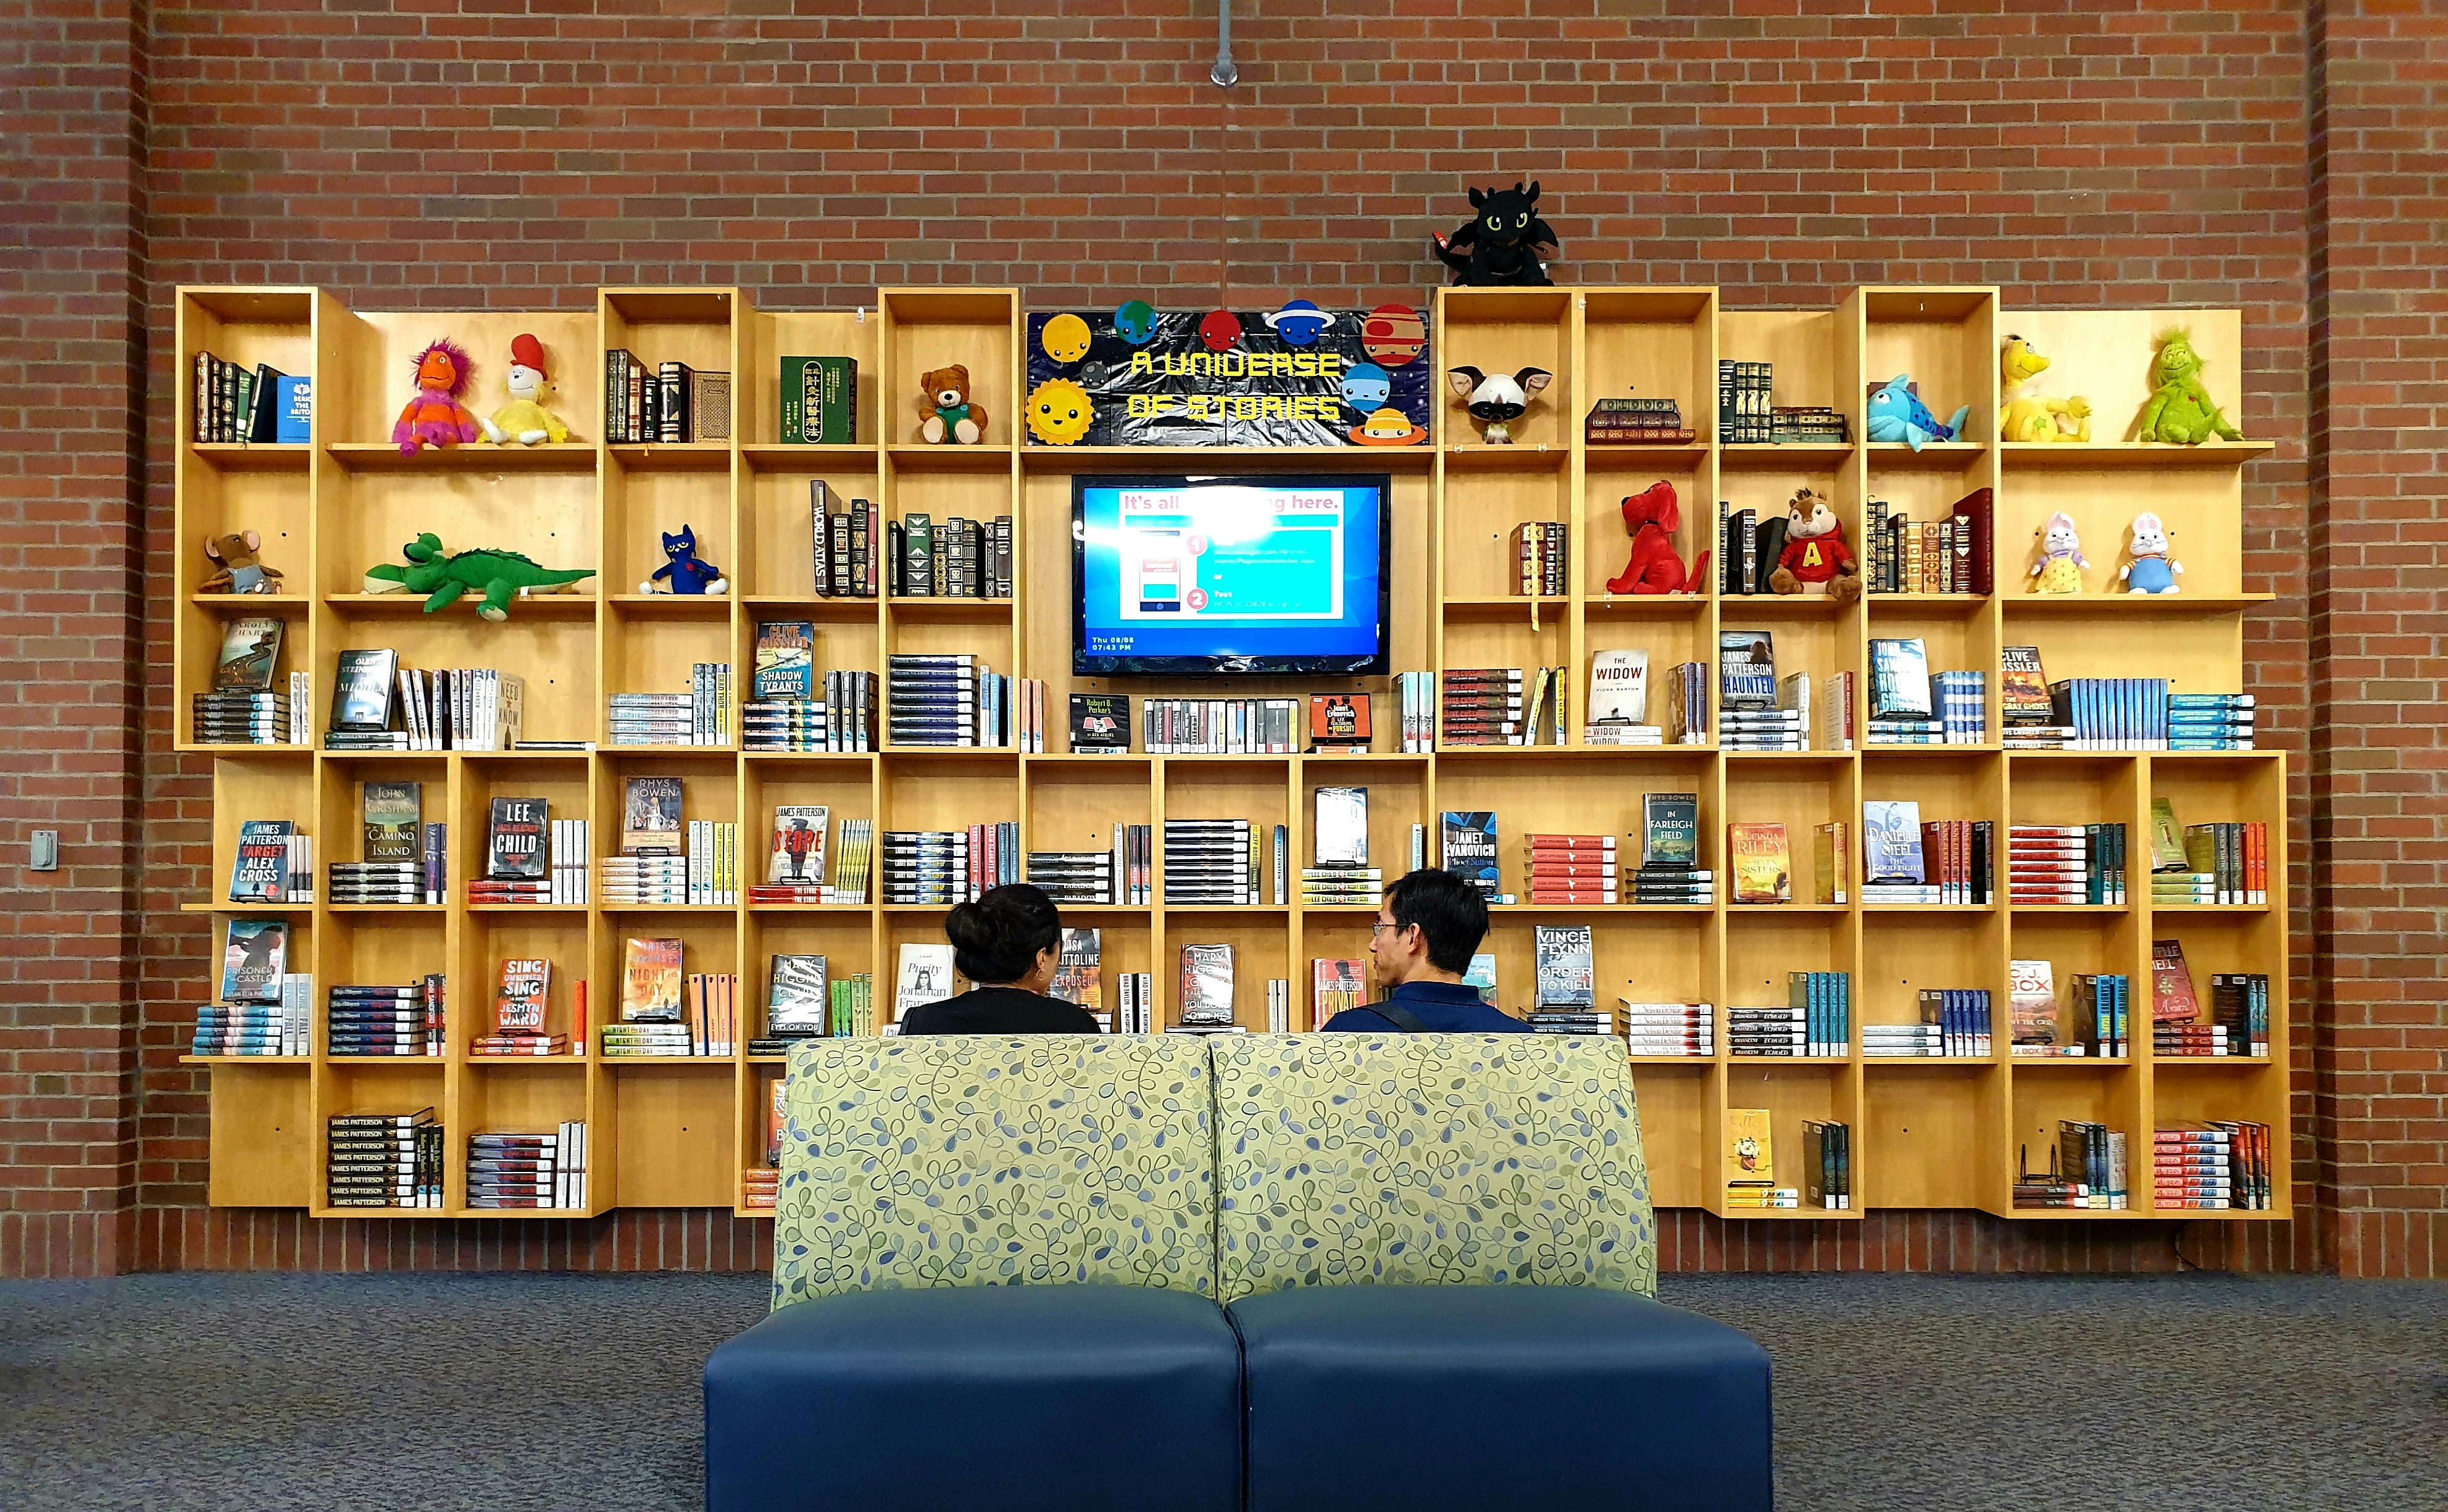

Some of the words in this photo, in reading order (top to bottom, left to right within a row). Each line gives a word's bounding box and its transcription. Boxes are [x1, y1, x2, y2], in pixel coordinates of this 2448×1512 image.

[1131, 351, 1153, 375] A
[1164, 352, 1341, 377] UNIVERSE
[1127, 395, 1173, 418] OF
[1186, 397, 1341, 421] STORIES
[1125, 496, 1152, 509] It's
[1158, 496, 1180, 509] all
[1292, 495, 1339, 509] here.
[1191, 537, 1201, 552] 1
[815, 545, 826, 577] ATLAS
[1802, 542, 1823, 567] A
[1192, 592, 1203, 605] 2
[768, 625, 801, 638] CLIVE
[760, 637, 808, 649] CUSSLER
[1722, 650, 1751, 663] JAMES
[762, 671, 802, 681] SHADOW
[1596, 667, 1642, 681] WIDOW
[1722, 663, 1772, 676] PATTERSON
[501, 682, 519, 701] NEED
[760, 681, 804, 691] TYRANTS
[1724, 676, 1774, 694] HAUNTED
[1086, 699, 1105, 707] Robert
[2002, 702, 2022, 710] GRAY
[2023, 702, 2049, 710] GHOST
[499, 708, 519, 726] KNOW
[1088, 706, 1112, 715] Parker's
[1593, 727, 1621, 736] WIDOW
[639, 779, 670, 787] RHYS
[378, 787, 406, 799] JOHN
[632, 789, 676, 797] BOWEN
[506, 804, 530, 822] LEE
[776, 807, 796, 817] JAMES
[796, 807, 826, 817] PATTERSON
[253, 825, 281, 834] JAMES
[1651, 820, 1692, 829] FARLEIGH
[241, 835, 288, 845] PATTERSON
[368, 829, 415, 841] CAMINO
[773, 830, 823, 852] STORE
[1455, 831, 1484, 844] JANET
[1660, 831, 1682, 839] FIELD
[1740, 833, 1779, 841] LUCINDA
[1869, 827, 1921, 842] DANIELLE
[373, 844, 410, 856] ISLAND
[496, 835, 537, 853] CHILD
[1446, 844, 1496, 857] EVANOVICH
[1737, 841, 1783, 854] RILEY
[1881, 841, 1913, 856] STEEL
[241, 845, 285, 858] TARGET
[246, 858, 273, 869] ALEX
[239, 869, 278, 882] CROSS
[1538, 931, 1590, 943] VINCE
[1063, 939, 1083, 952] LISA
[1539, 943, 1590, 955] FLYNN
[1194, 952, 1224, 963] MARY
[227, 966, 273, 975] PRISONER
[506, 960, 544, 974] SING,
[907, 963, 942, 976] Purity
[1539, 966, 1591, 978] ORDER
[2028, 969, 2040, 978] J.
[236, 974, 272, 982] CASTLE
[630, 968, 665, 981] NIGHT
[1055, 974, 1093, 987] EXPOSED
[504, 981, 540, 995] SING
[641, 984, 663, 996] DAY
[899, 985, 946, 997] Jonathan
[1335, 979, 1364, 992] PATTERSON
[1541, 979, 1557, 991] TO
[1560, 979, 1591, 991] KILL
[2011, 979, 2049, 991] BOX
[499, 1003, 539, 1013] JESMYN
[1184, 1000, 1202, 1009] YOU
[1322, 991, 1359, 1014] PRIVATE
[499, 1013, 539, 1026] WARD
